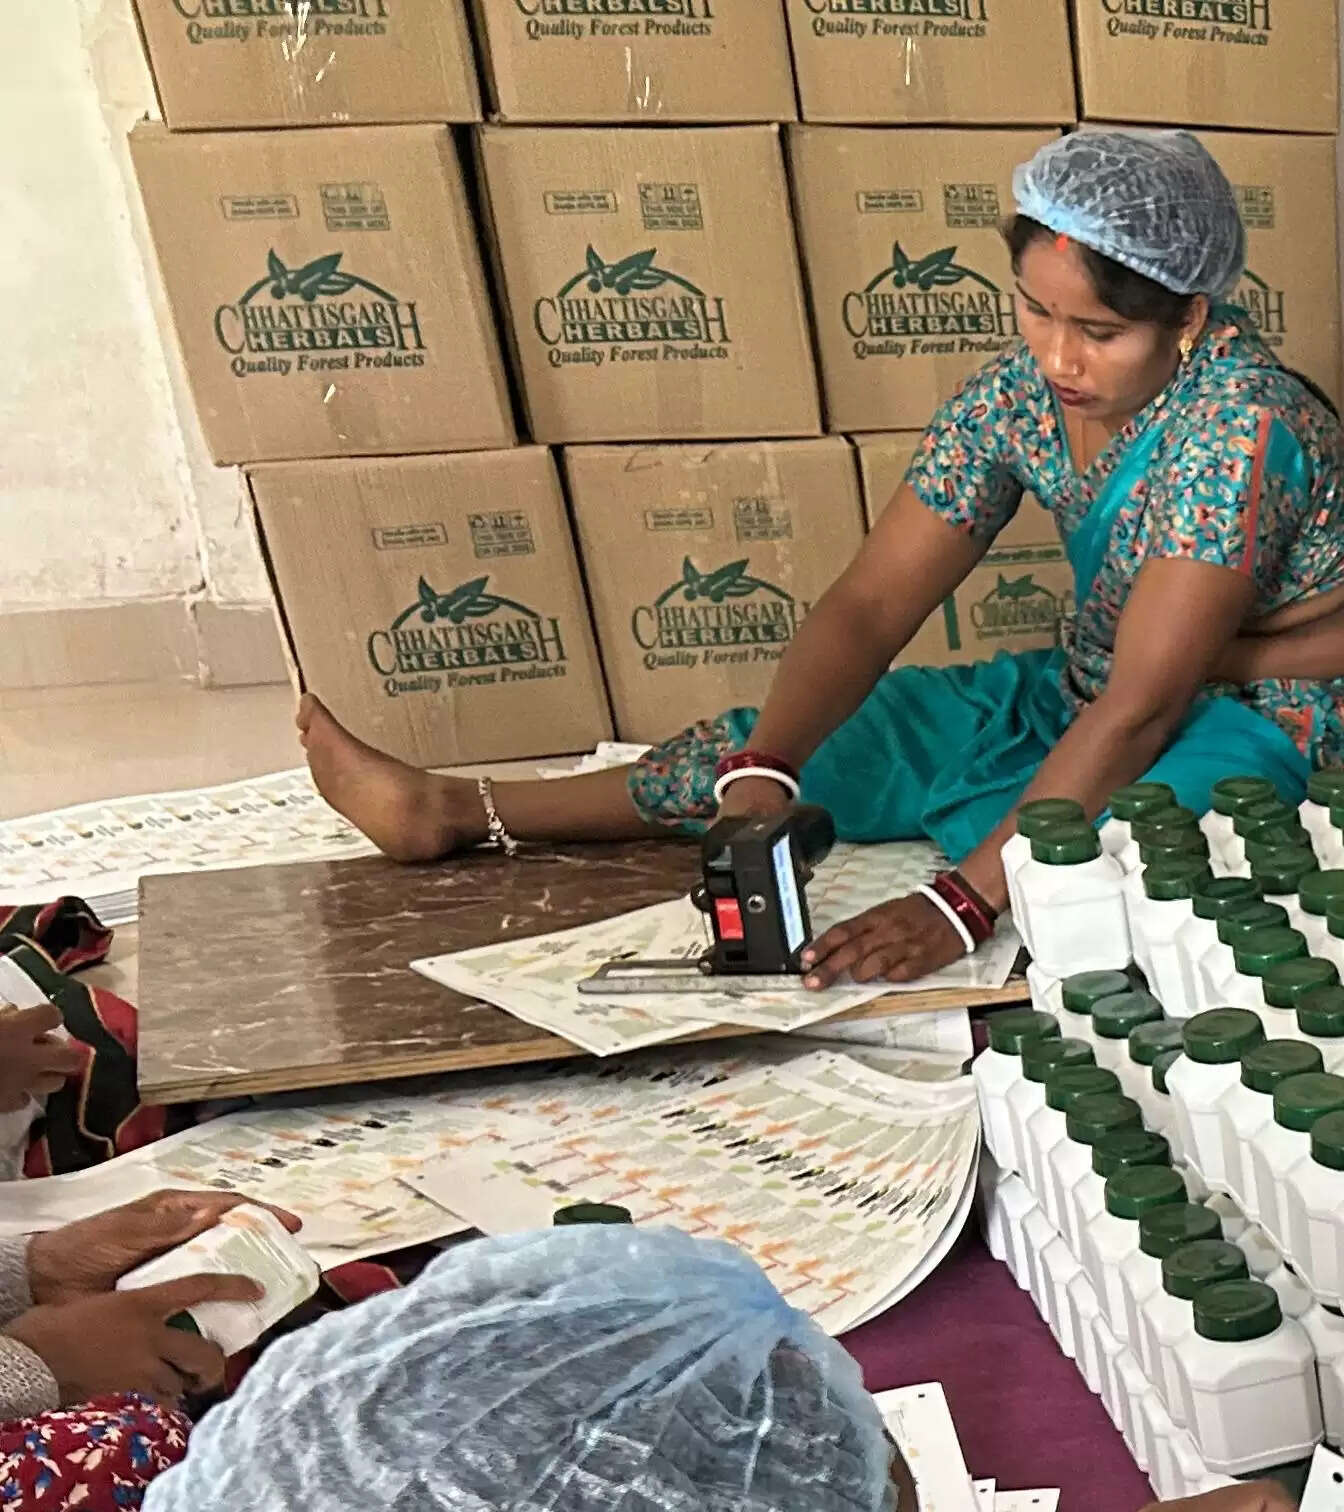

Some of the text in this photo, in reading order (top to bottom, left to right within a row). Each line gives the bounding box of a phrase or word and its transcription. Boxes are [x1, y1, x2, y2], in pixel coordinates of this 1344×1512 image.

[206, 0, 356, 15] HERLS
[1126, 0, 1248, 23] HERBALS
[186, 21, 249, 44] Quality
[315, 18, 387, 36] Products
[526, 18, 711, 40] Quality Forest Products
[812, 17, 987, 38] Quality Forest Products
[1107, 16, 1270, 46] Quality Forest Products
[534, 296, 732, 345] CHHATTISGARH
[842, 291, 1022, 338] CHHATTISGARH
[872, 316, 993, 334] HERBALS
[214, 301, 427, 354] CHHATTISGARH
[250, 328, 392, 350] HERBALS
[564, 322, 700, 342] HERBALS
[549, 344, 729, 368] Quality Forest Products
[853, 339, 906, 359] Quality
[910, 338, 956, 355] Forest
[231, 352, 425, 377] Quality Forest Products
[368, 616, 568, 676] CHHATTISGARH
[661, 627, 789, 649] HERBALS
[400, 642, 538, 672] HERBALS
[643, 652, 698, 671] Quality
[702, 649, 749, 665] Forest
[384, 664, 567, 697] Quality Forest Products
